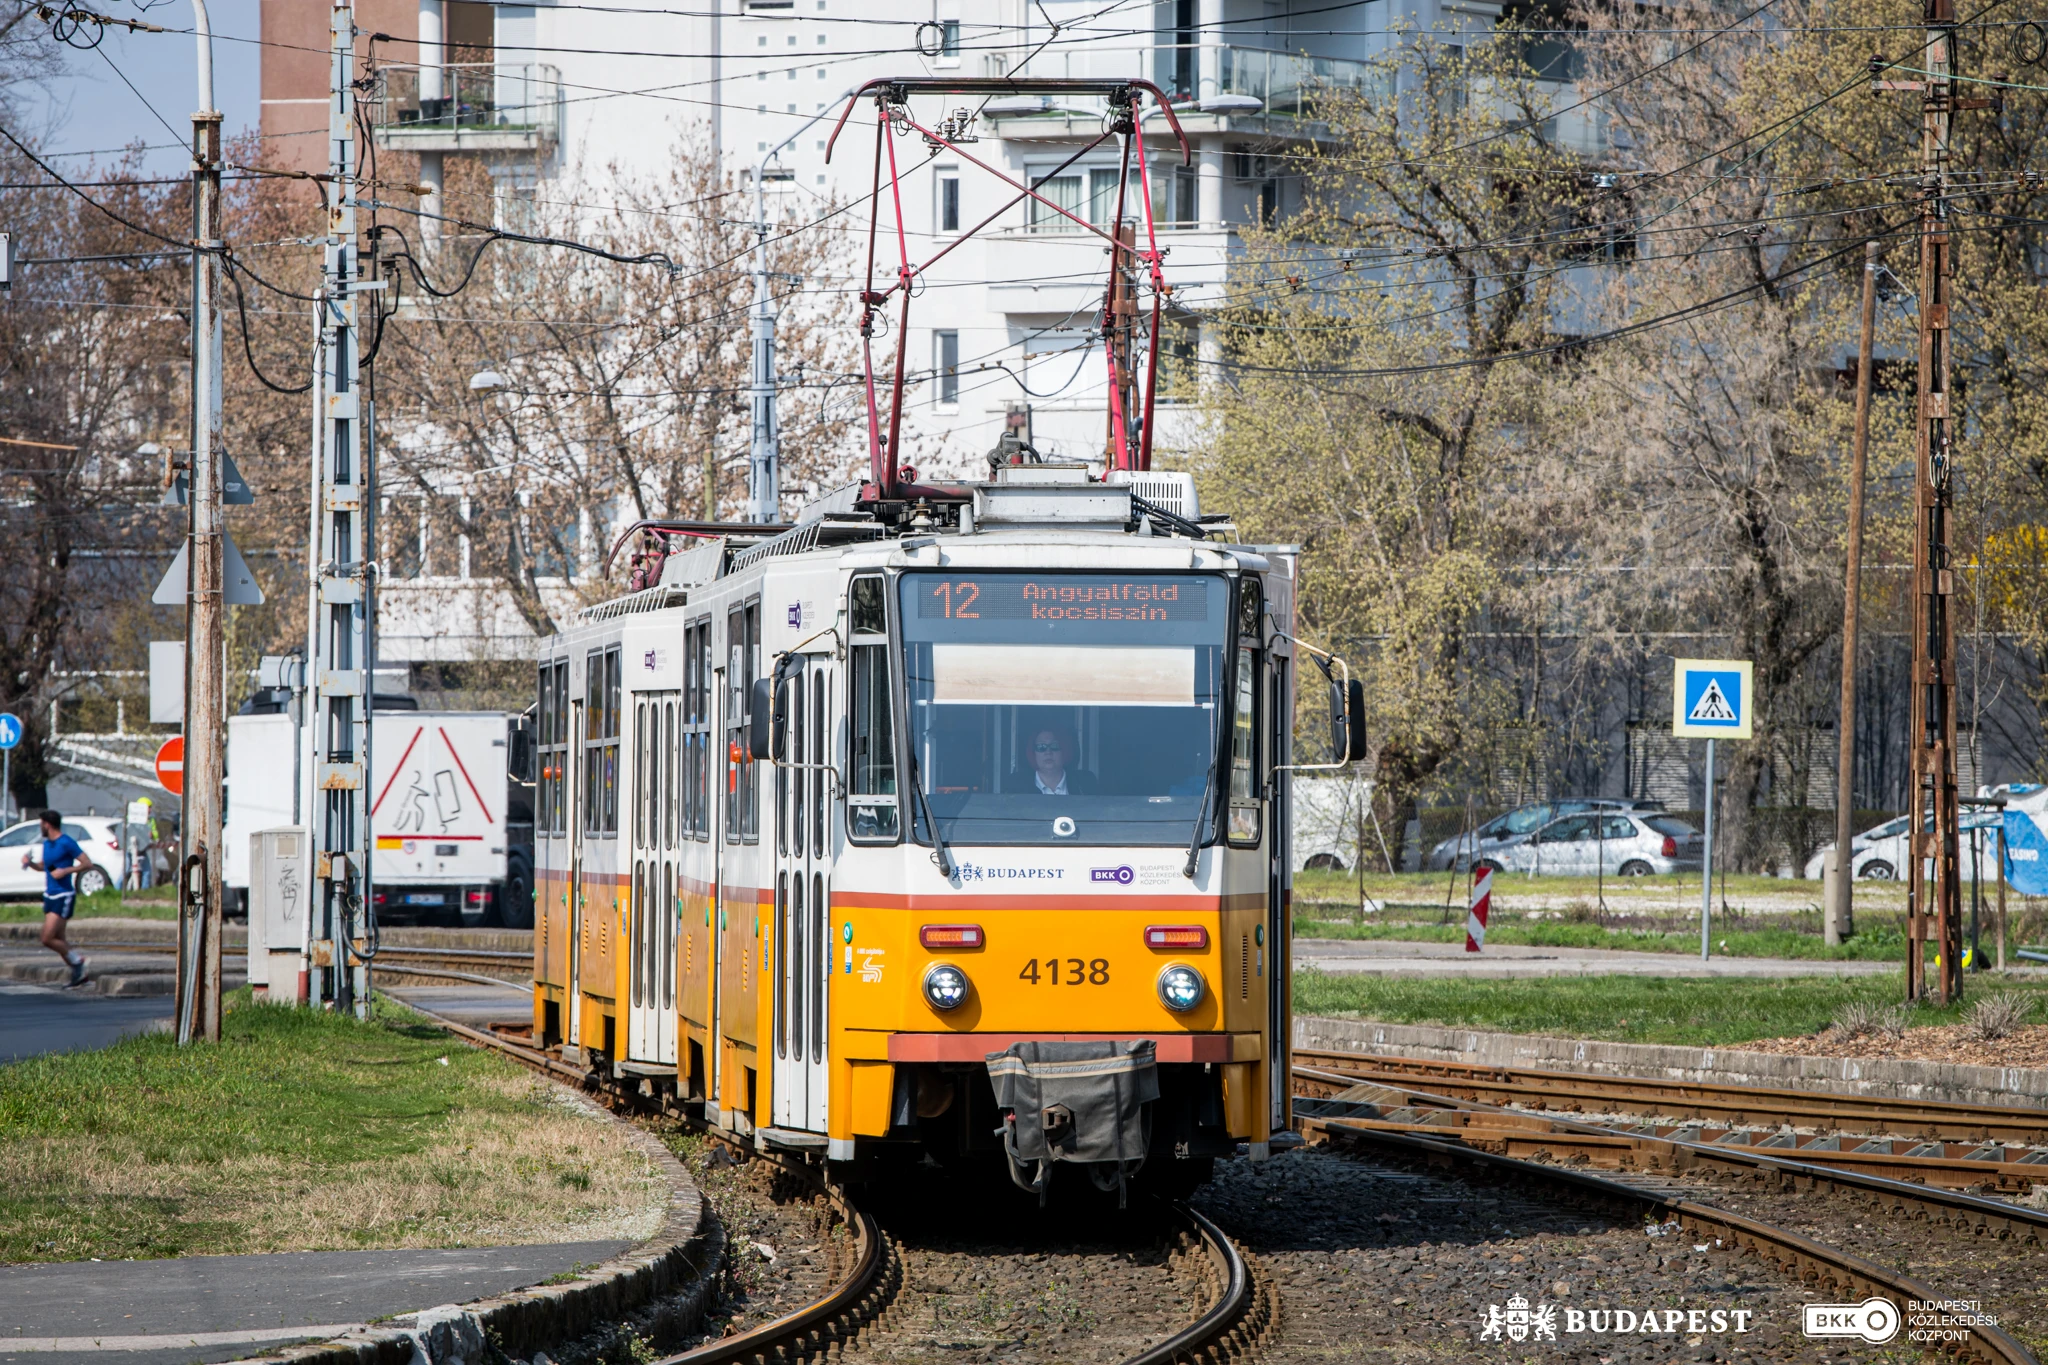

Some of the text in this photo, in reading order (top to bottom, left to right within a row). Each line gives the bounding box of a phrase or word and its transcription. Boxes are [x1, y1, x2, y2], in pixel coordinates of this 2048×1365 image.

[933, 582, 1178, 618] 12 Angyalföld
[1032, 603, 1166, 620] kocsiszín
[988, 868, 1064, 879] BUDAPEST
[1095, 871, 1115, 879] BKK
[1019, 958, 1110, 985] 4138
